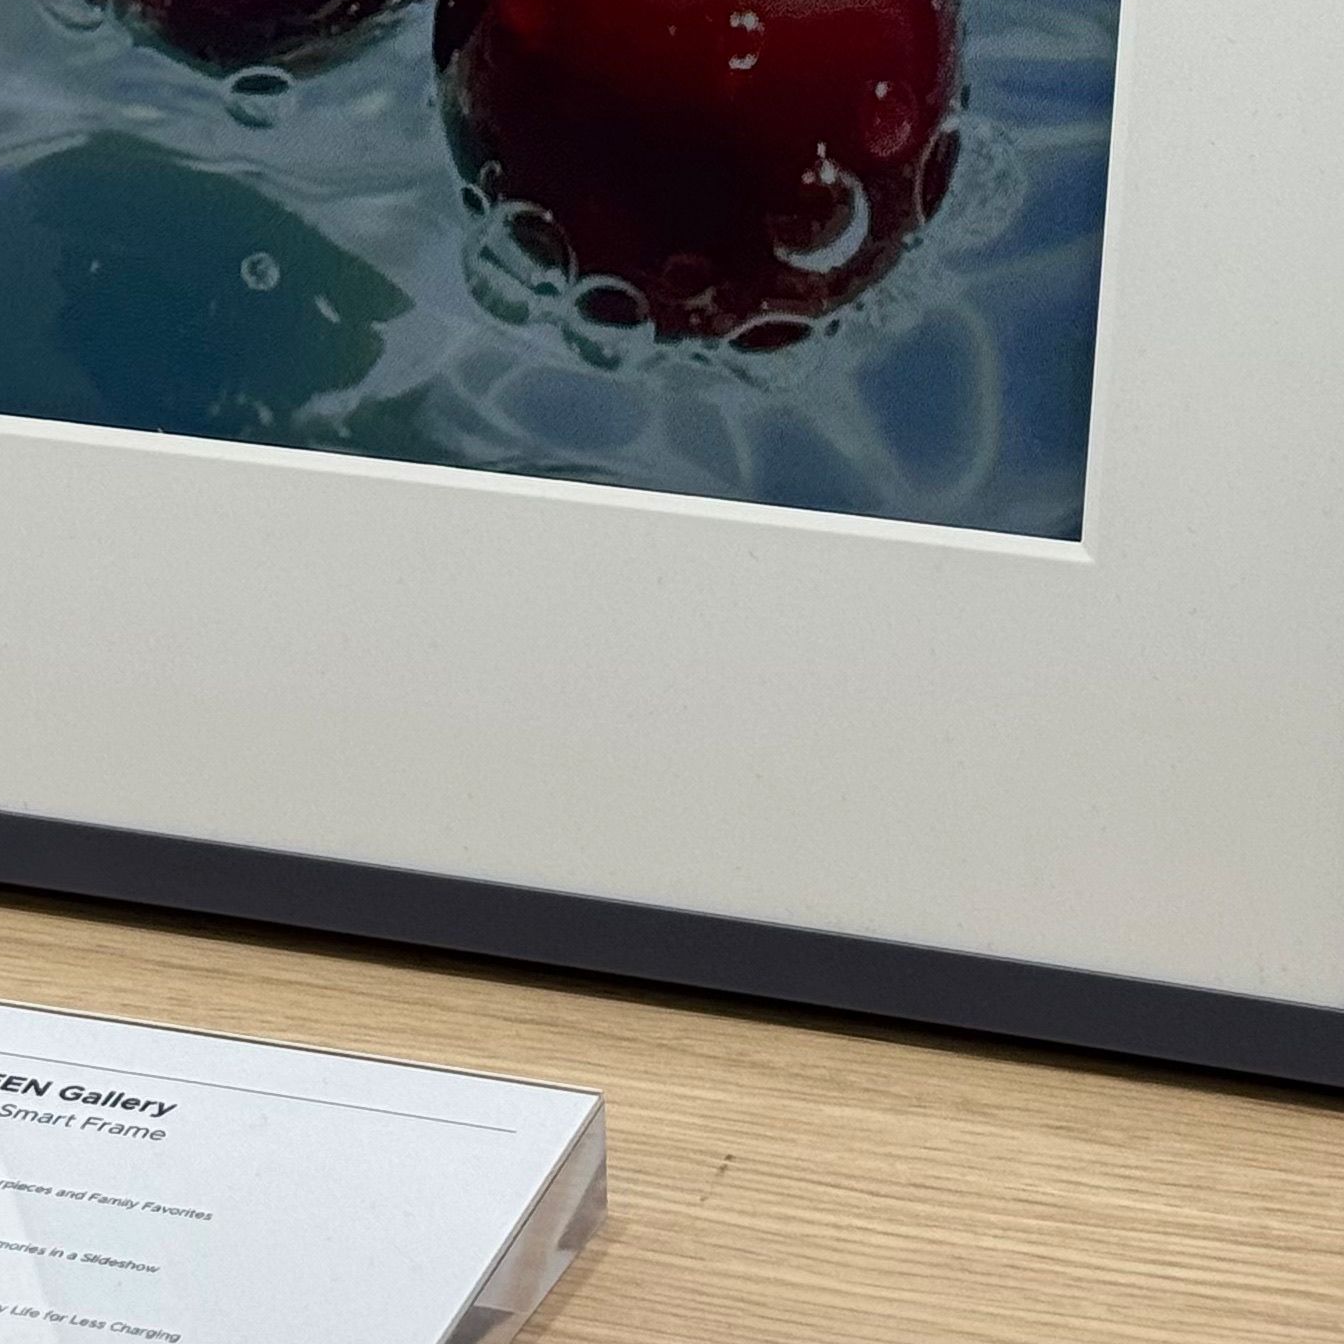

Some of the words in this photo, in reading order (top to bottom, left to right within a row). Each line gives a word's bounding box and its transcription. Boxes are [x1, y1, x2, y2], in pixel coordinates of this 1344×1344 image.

[58, 1085, 178, 1118] Gallery
[80, 1116, 167, 1141] Frame
[55, 1188, 88, 1201] and
[88, 1192, 140, 1211] Family
[141, 1201, 214, 1222] Favorites
[49, 1246, 65, 1259] in
[65, 1251, 79, 1261] a
[80, 1251, 161, 1274] Slideshow
[10, 1304, 41, 1320] Life
[43, 1309, 68, 1324] for
[69, 1314, 107, 1331] Less
[109, 1321, 182, 1344] Charging
